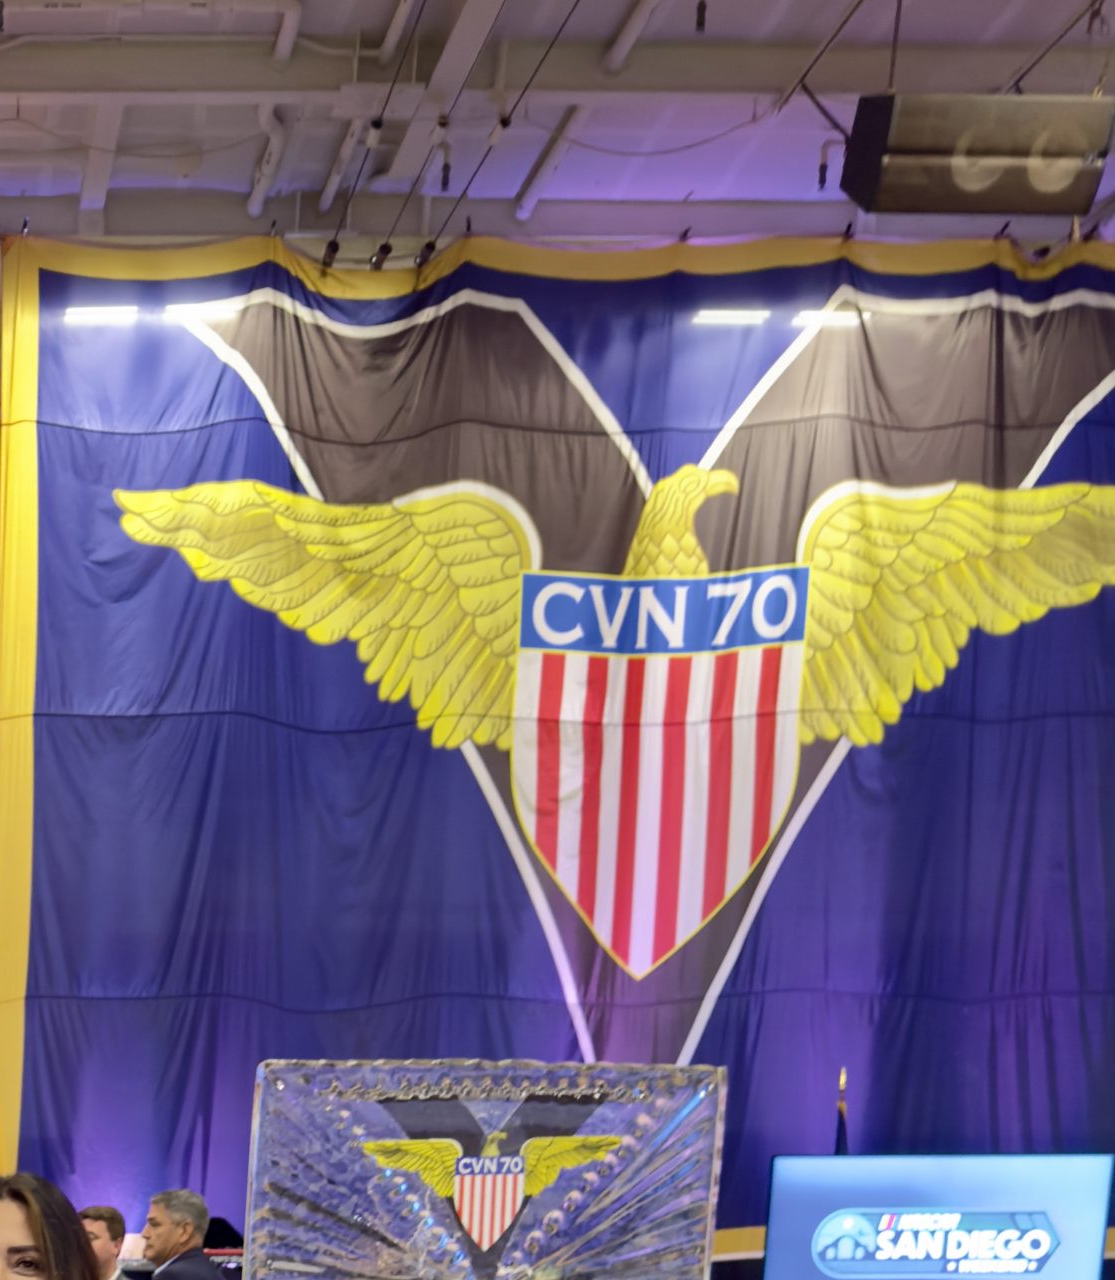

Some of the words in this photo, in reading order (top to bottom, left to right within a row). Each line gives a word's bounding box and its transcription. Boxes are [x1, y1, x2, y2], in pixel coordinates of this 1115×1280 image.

[532, 581, 689, 649] CVN
[706, 574, 797, 646] 70
[458, 1157, 498, 1174] CVN
[500, 1156, 523, 1173] 70
[875, 1229, 944, 1260] SAN
[946, 1229, 1051, 1260] DIEGO
